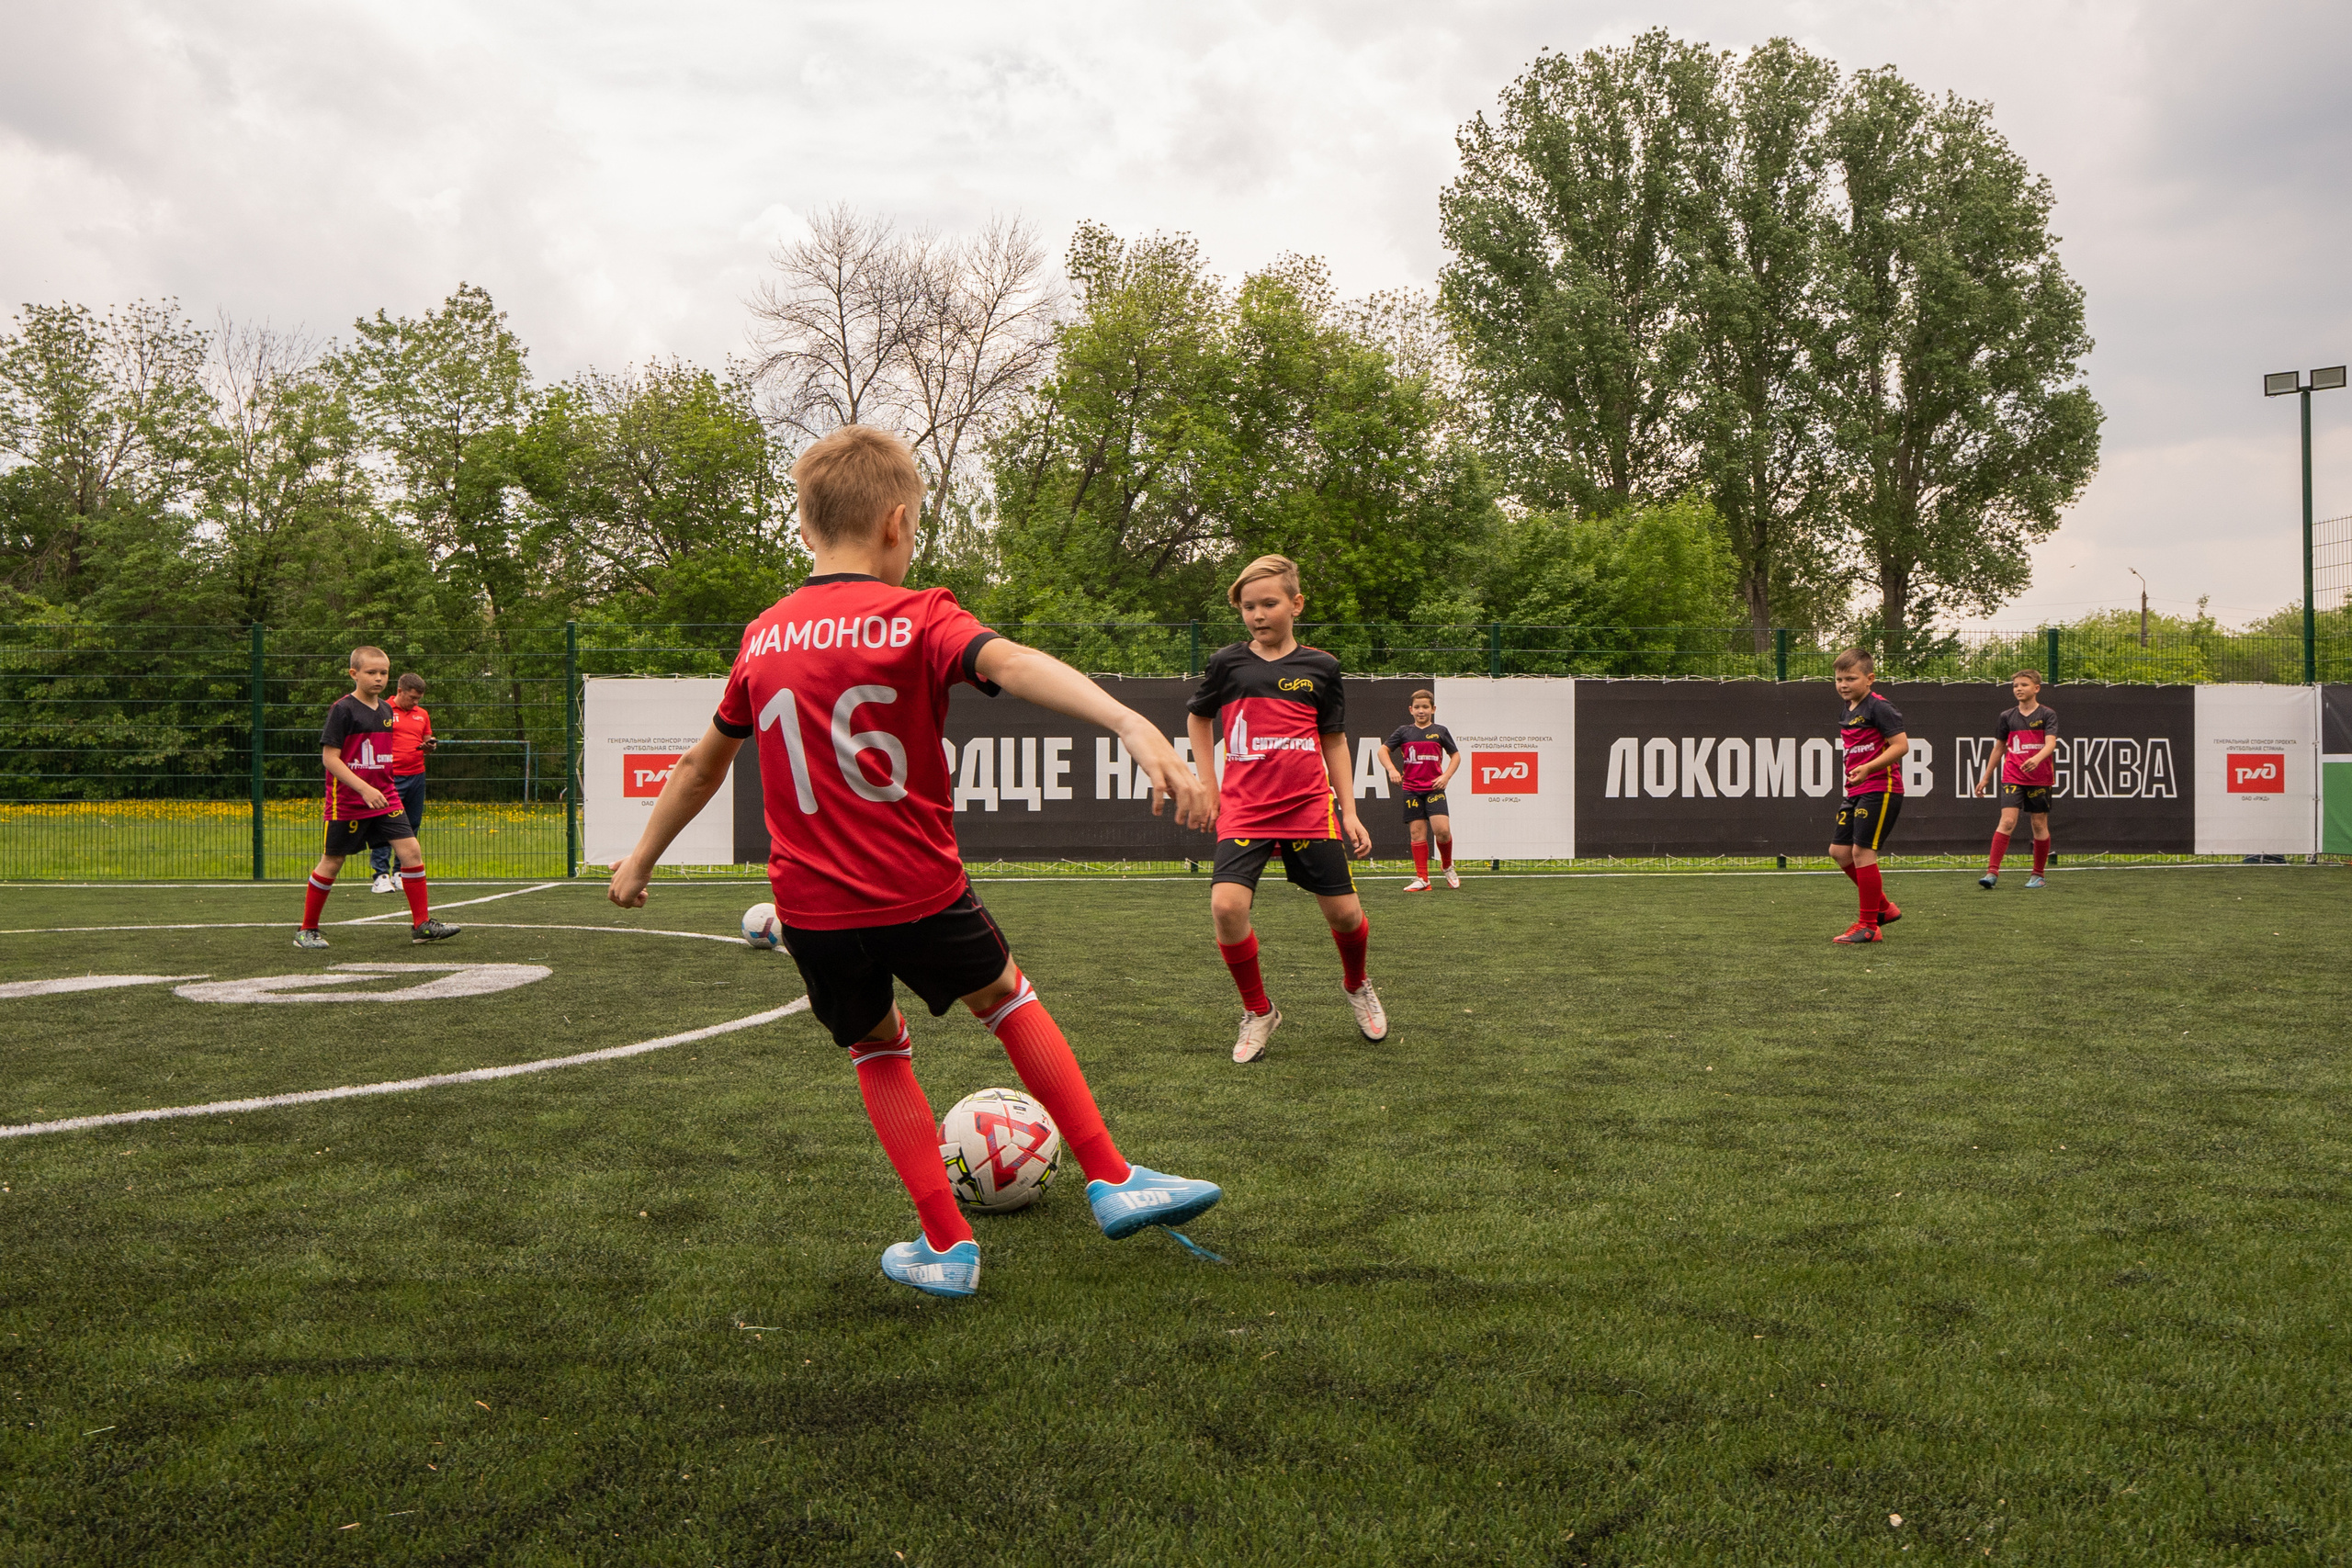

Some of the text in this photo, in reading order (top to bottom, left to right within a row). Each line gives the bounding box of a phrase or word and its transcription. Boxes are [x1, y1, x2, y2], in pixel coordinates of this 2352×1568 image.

[745, 615, 912, 663] МАМОНОВ
[759, 684, 909, 815] 16
[1251, 737, 1316, 751] СИТИСТРОЙ
[1605, 738, 2177, 798] ЛОКОМОВ МСКВА
[2004, 784, 2017, 795] 17
[1406, 798, 1419, 808] 14
[1836, 811, 1847, 825] 2
[349, 820, 358, 833] 9
